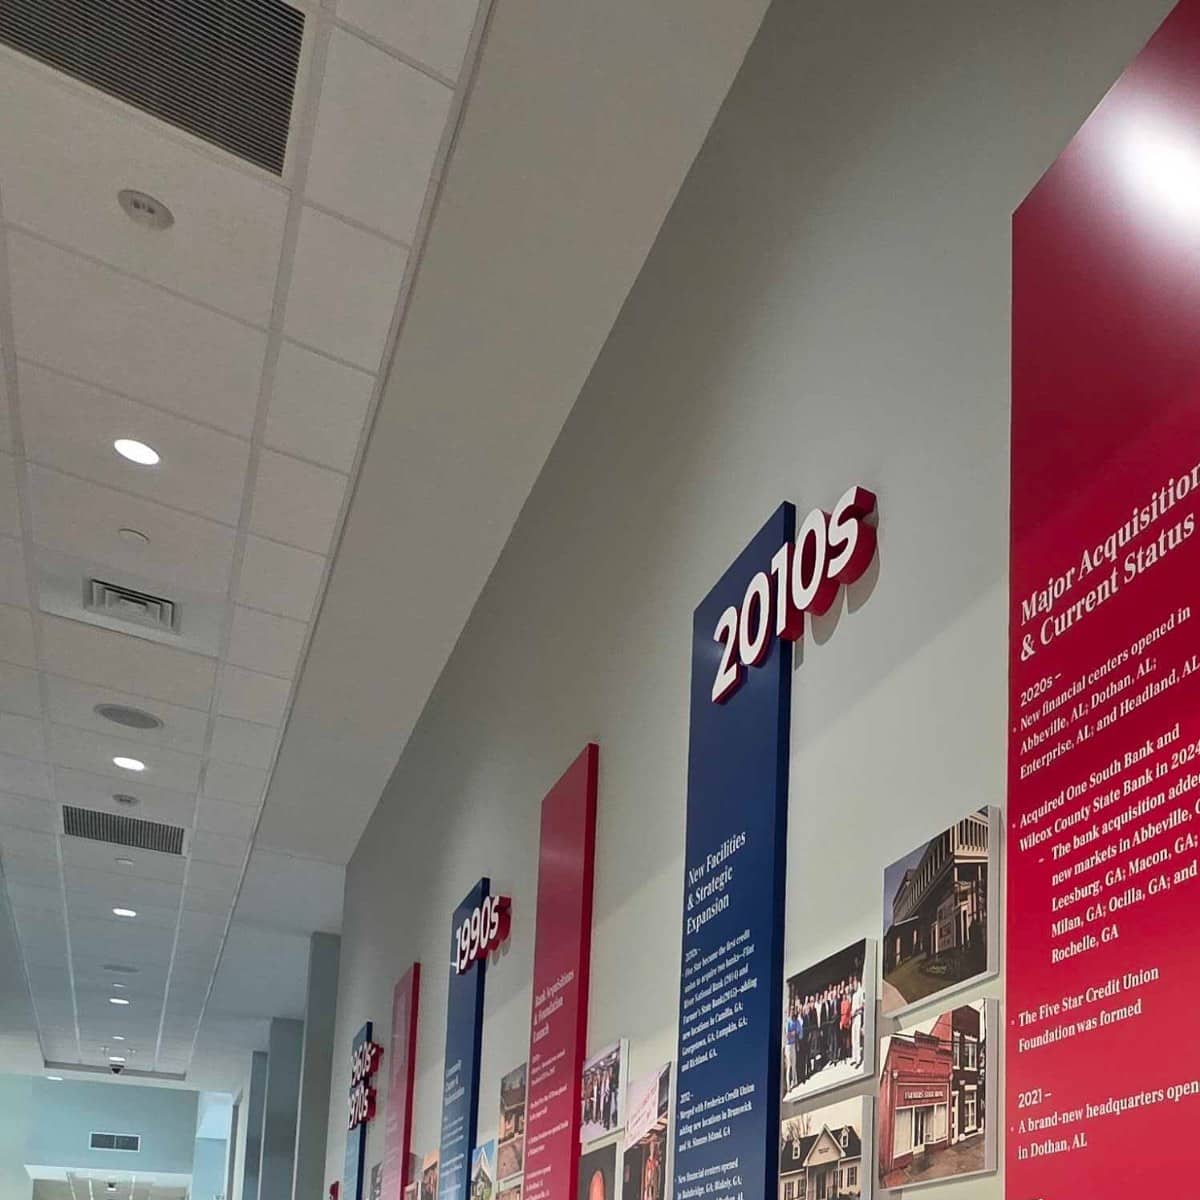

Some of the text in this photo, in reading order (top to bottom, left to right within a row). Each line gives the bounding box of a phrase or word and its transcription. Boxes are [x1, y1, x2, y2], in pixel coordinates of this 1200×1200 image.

[711, 486, 860, 702] 2010s
[1020, 512, 1195, 662] & Current Status
[1021, 566, 1076, 626] Major
[1020, 606, 1191, 731] New financial centers opened in
[1020, 676, 1053, 707] 2020s
[1020, 717, 1069, 756] Abbeville,
[1090, 674, 1135, 709] Dothan,
[1020, 739, 1074, 780] Enterprise,
[1096, 706, 1117, 732] and
[1120, 668, 1180, 717] Headland,
[1181, 655, 1200, 678] AL
[1018, 826, 1053, 852] Wilcox
[1054, 804, 1091, 834] County
[1092, 789, 1121, 813] State
[1123, 768, 1154, 797] Bank
[1155, 762, 1168, 779] in
[1020, 722, 1180, 829] Acquired One South Bank and
[706, 832, 746, 872] Facilities
[1052, 842, 1072, 861] The
[1073, 824, 1100, 850] bank
[1101, 792, 1166, 835] acquisition
[1052, 867, 1073, 887] new
[1074, 844, 1118, 876] markets
[1118, 838, 1131, 854] in
[1131, 808, 1192, 847] Abbeville,
[695, 866, 733, 904] Strategic
[1052, 859, 1200, 938] Milan, GA; Ocilla, GA; and
[1053, 832, 1198, 912] Leesburg, GA; Macon, GA;
[456, 895, 500, 975] 1990s
[686, 894, 729, 935] Expansion
[1052, 923, 1120, 964] Rochelle, GA
[1018, 967, 1160, 1027] The Five Star Credit Union
[1018, 998, 1142, 1053] Foundation was formed
[1018, 1088, 1042, 1109] 2021
[1018, 1120, 1027, 1134] A
[1027, 1108, 1084, 1132] brand-new
[1086, 1089, 1164, 1120] headquarters
[1018, 1132, 1088, 1160] in Dothan, AL
